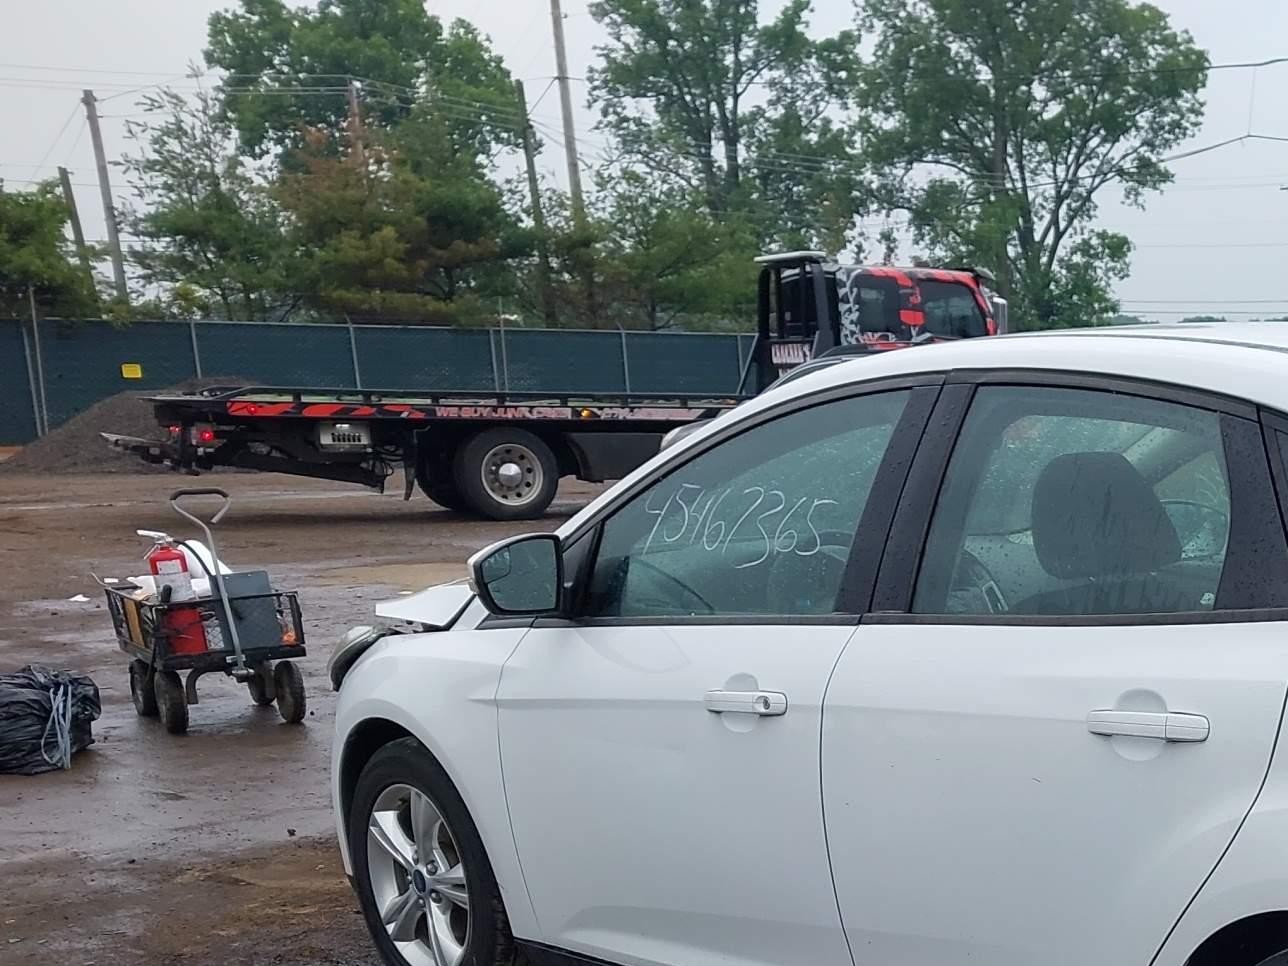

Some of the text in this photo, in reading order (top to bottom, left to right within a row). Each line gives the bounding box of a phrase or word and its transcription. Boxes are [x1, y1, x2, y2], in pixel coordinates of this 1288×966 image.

[435, 406, 458, 417] WE
[460, 406, 490, 417] BUY
[491, 406, 531, 418] JUNK
[641, 483, 839, 569] 45467365
